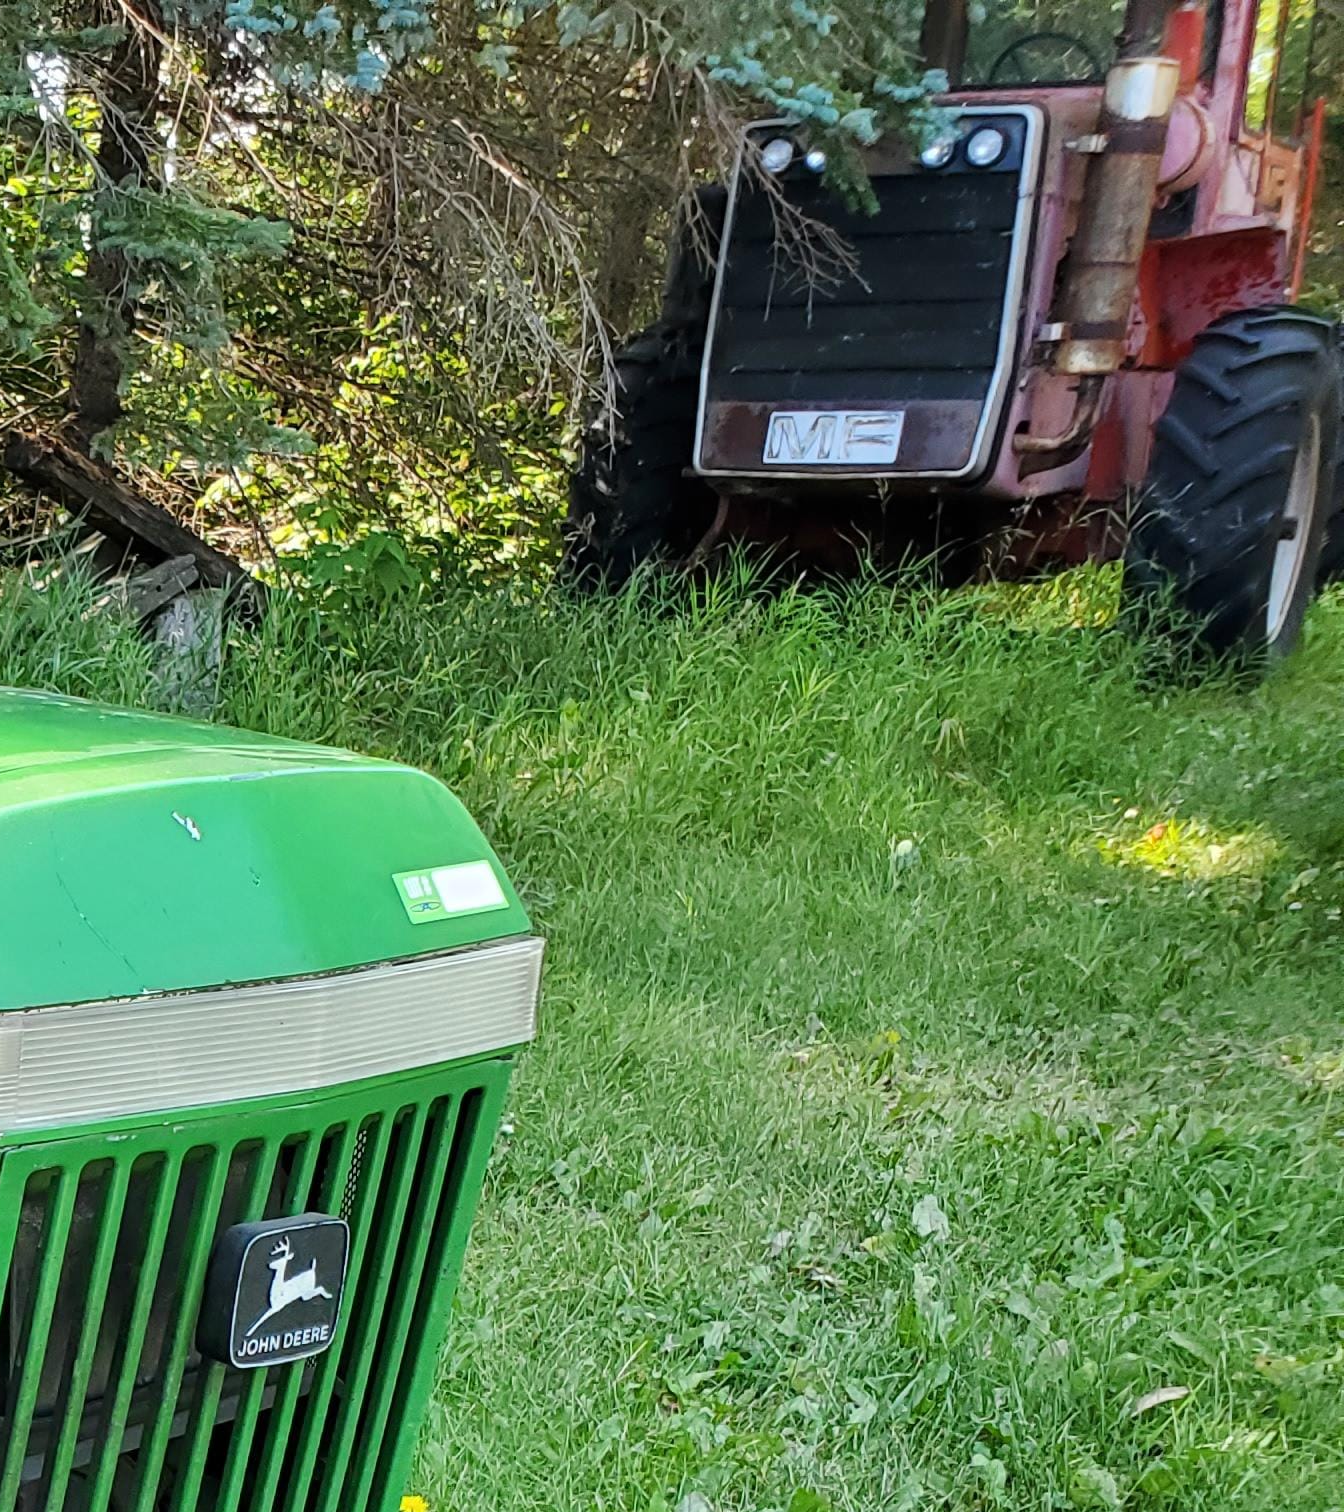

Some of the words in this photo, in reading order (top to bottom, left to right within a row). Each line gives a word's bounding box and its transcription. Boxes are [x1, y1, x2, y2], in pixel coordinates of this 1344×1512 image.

[766, 413, 900, 461] MF
[237, 1336, 281, 1357] JOHN
[283, 1325, 330, 1349] DEERE
